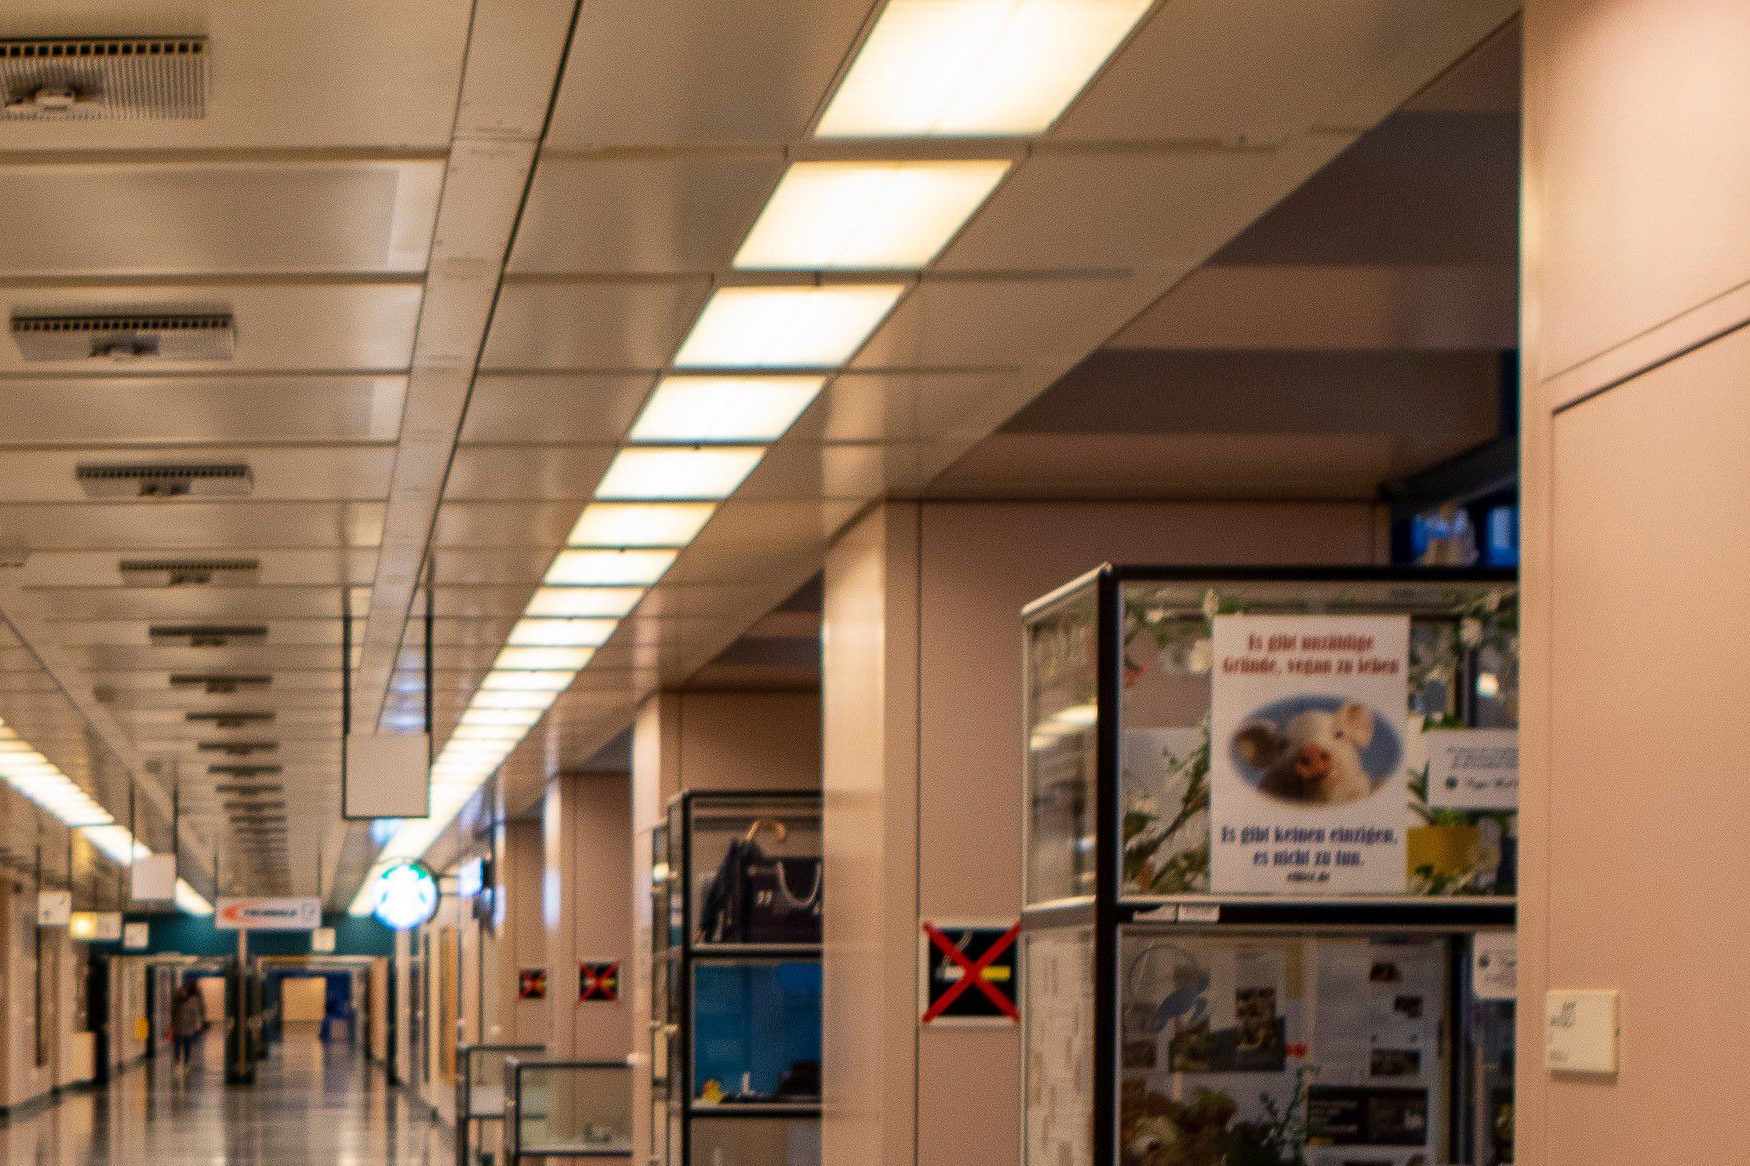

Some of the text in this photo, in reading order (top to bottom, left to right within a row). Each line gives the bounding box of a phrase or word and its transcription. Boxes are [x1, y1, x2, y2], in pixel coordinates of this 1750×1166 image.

[1248, 634, 1262, 650] Es
[1268, 634, 1296, 652] gibt
[1288, 659, 1332, 676] vegan
[1337, 660, 1353, 674] zu
[1221, 827, 1236, 842] Es
[1241, 827, 1270, 844] gibt
[1275, 827, 1325, 843] keinen
[1253, 852, 1269, 866] es
[1274, 851, 1310, 866] nicht
[1315, 852, 1331, 866] zu
